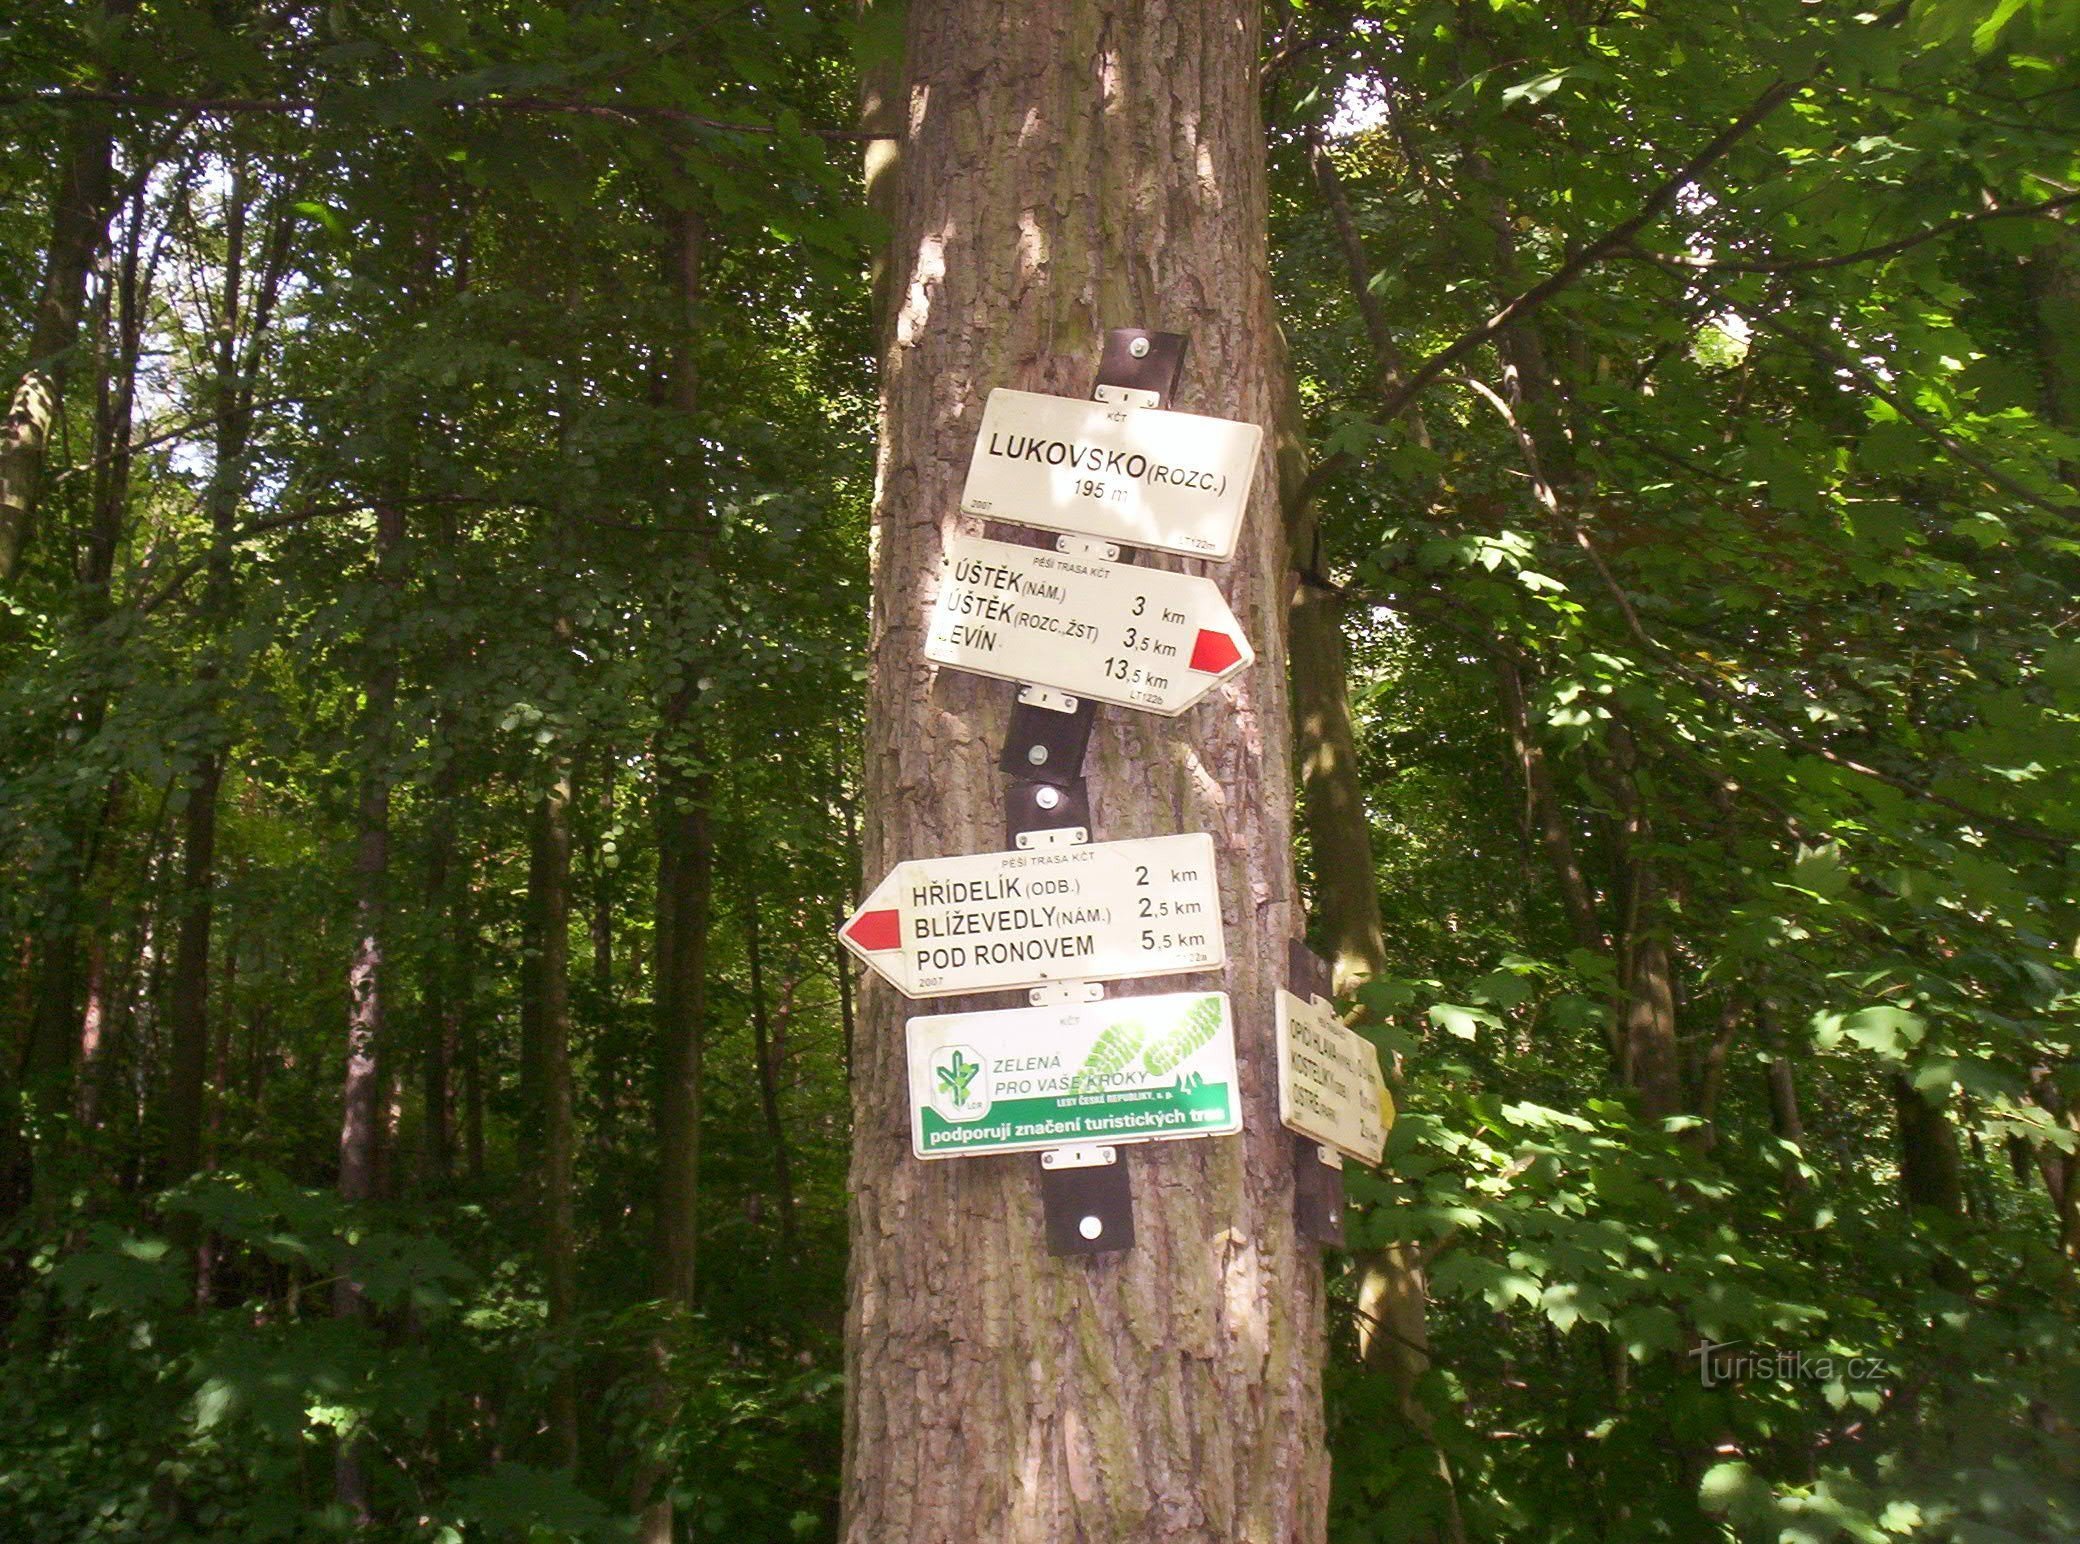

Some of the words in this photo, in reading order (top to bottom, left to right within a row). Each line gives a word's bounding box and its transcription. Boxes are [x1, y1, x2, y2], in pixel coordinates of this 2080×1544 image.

[1074, 478, 1105, 500] 195
[1056, 560, 1089, 577] TRASA
[1090, 567, 1111, 580] KČT
[1132, 596, 1146, 616] 3
[1162, 607, 1186, 625] km
[1123, 627, 1149, 651] 3,5
[1153, 638, 1177, 657] km
[939, 624, 997, 652] EVÍN
[1104, 656, 1142, 685] 13,5
[1145, 671, 1169, 690] km
[1031, 855, 1069, 866] TRASA
[1072, 850, 1095, 861] KČT
[913, 875, 1022, 907] HŘÍDELÍK
[1026, 878, 1080, 897] (ODB.)
[1135, 866, 1150, 886] 2
[1171, 868, 1198, 883] km
[1138, 897, 1168, 919] 2,5
[1174, 900, 1202, 915] km
[917, 947, 966, 971] POD
[975, 935, 1095, 966] RONOVEM
[1141, 930, 1172, 952] 5,5
[1178, 933, 1206, 947] km
[993, 1051, 1061, 1074] ZELENÁ
[995, 1080, 1034, 1096] PRO
[1038, 1074, 1080, 1093] VAŠE
[1085, 1071, 1149, 1091] KROKY
[930, 1121, 1011, 1146] podporují
[1015, 1115, 1081, 1136] značení
[1084, 1108, 1186, 1131] turistických
[1189, 1108, 1226, 1122] tr
